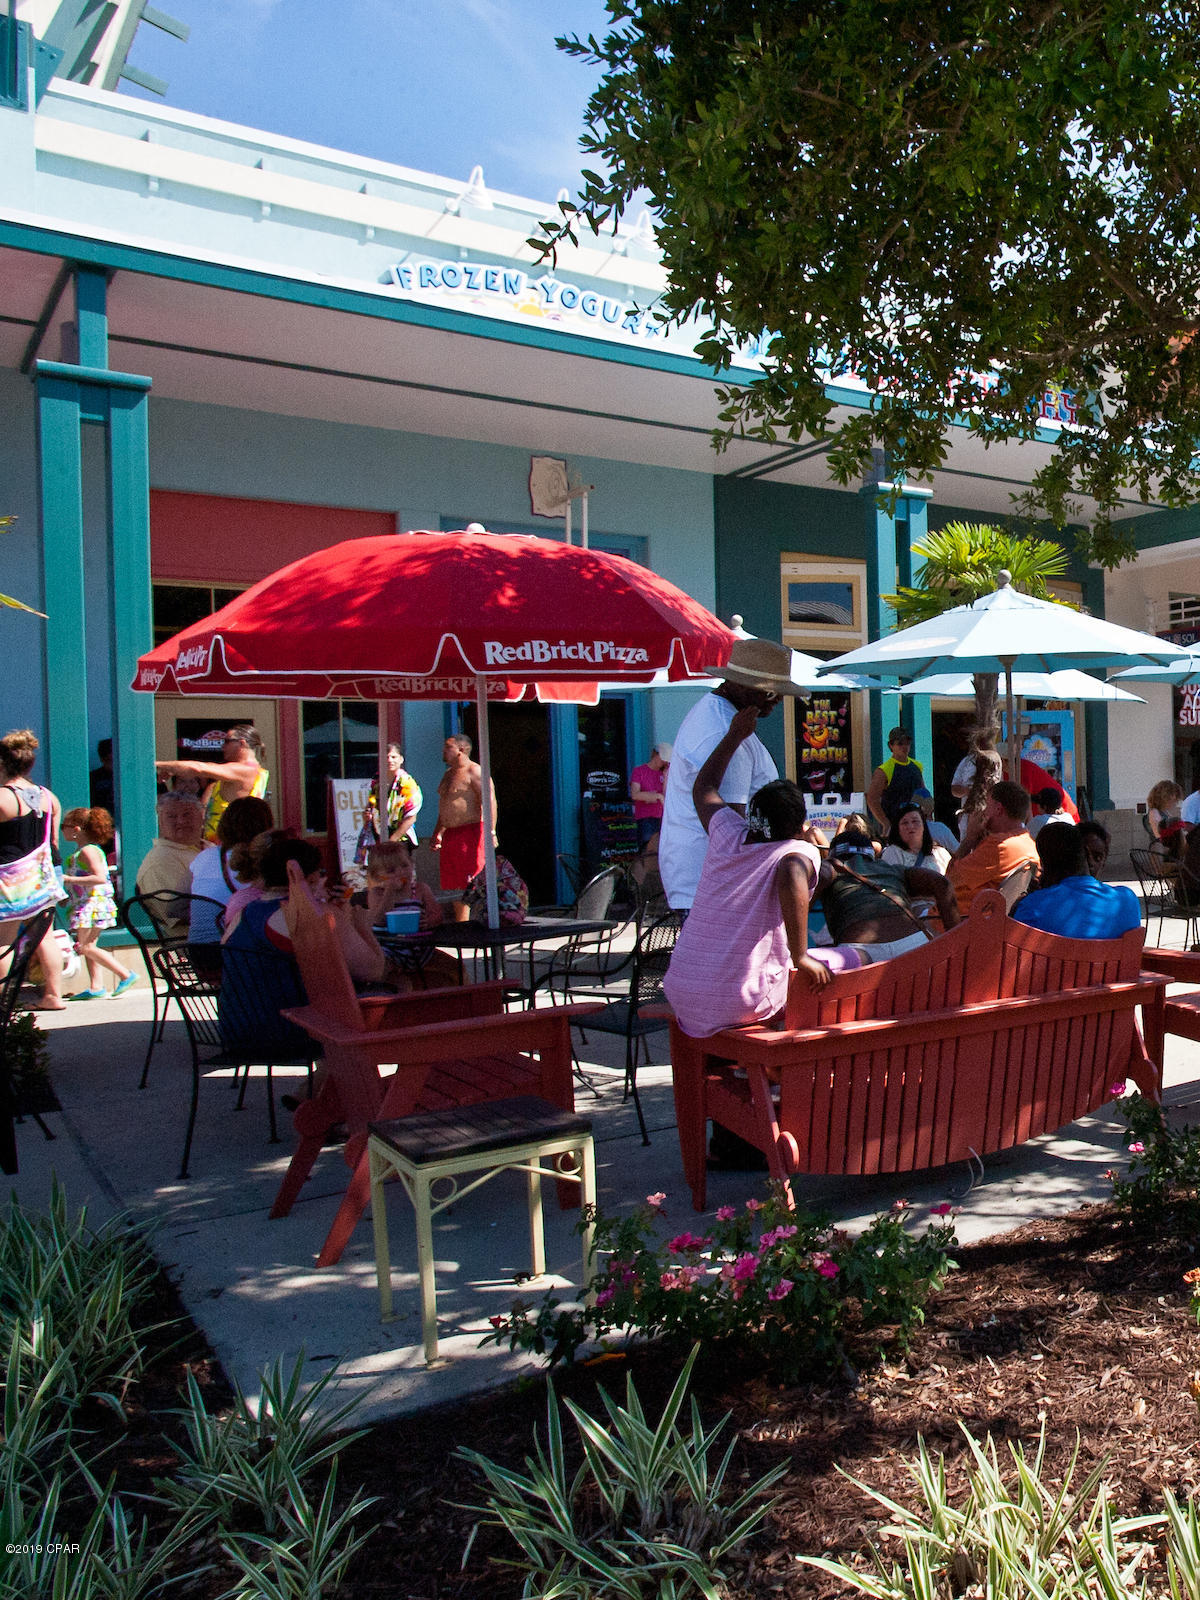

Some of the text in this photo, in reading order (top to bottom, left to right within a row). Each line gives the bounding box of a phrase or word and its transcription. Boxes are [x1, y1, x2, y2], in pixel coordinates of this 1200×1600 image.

[395, 263, 660, 338] FROZEN YOGURT
[483, 640, 649, 665] RedBrickPizza
[806, 710, 838, 724] BEST
[801, 746, 848, 763] EARTH!
